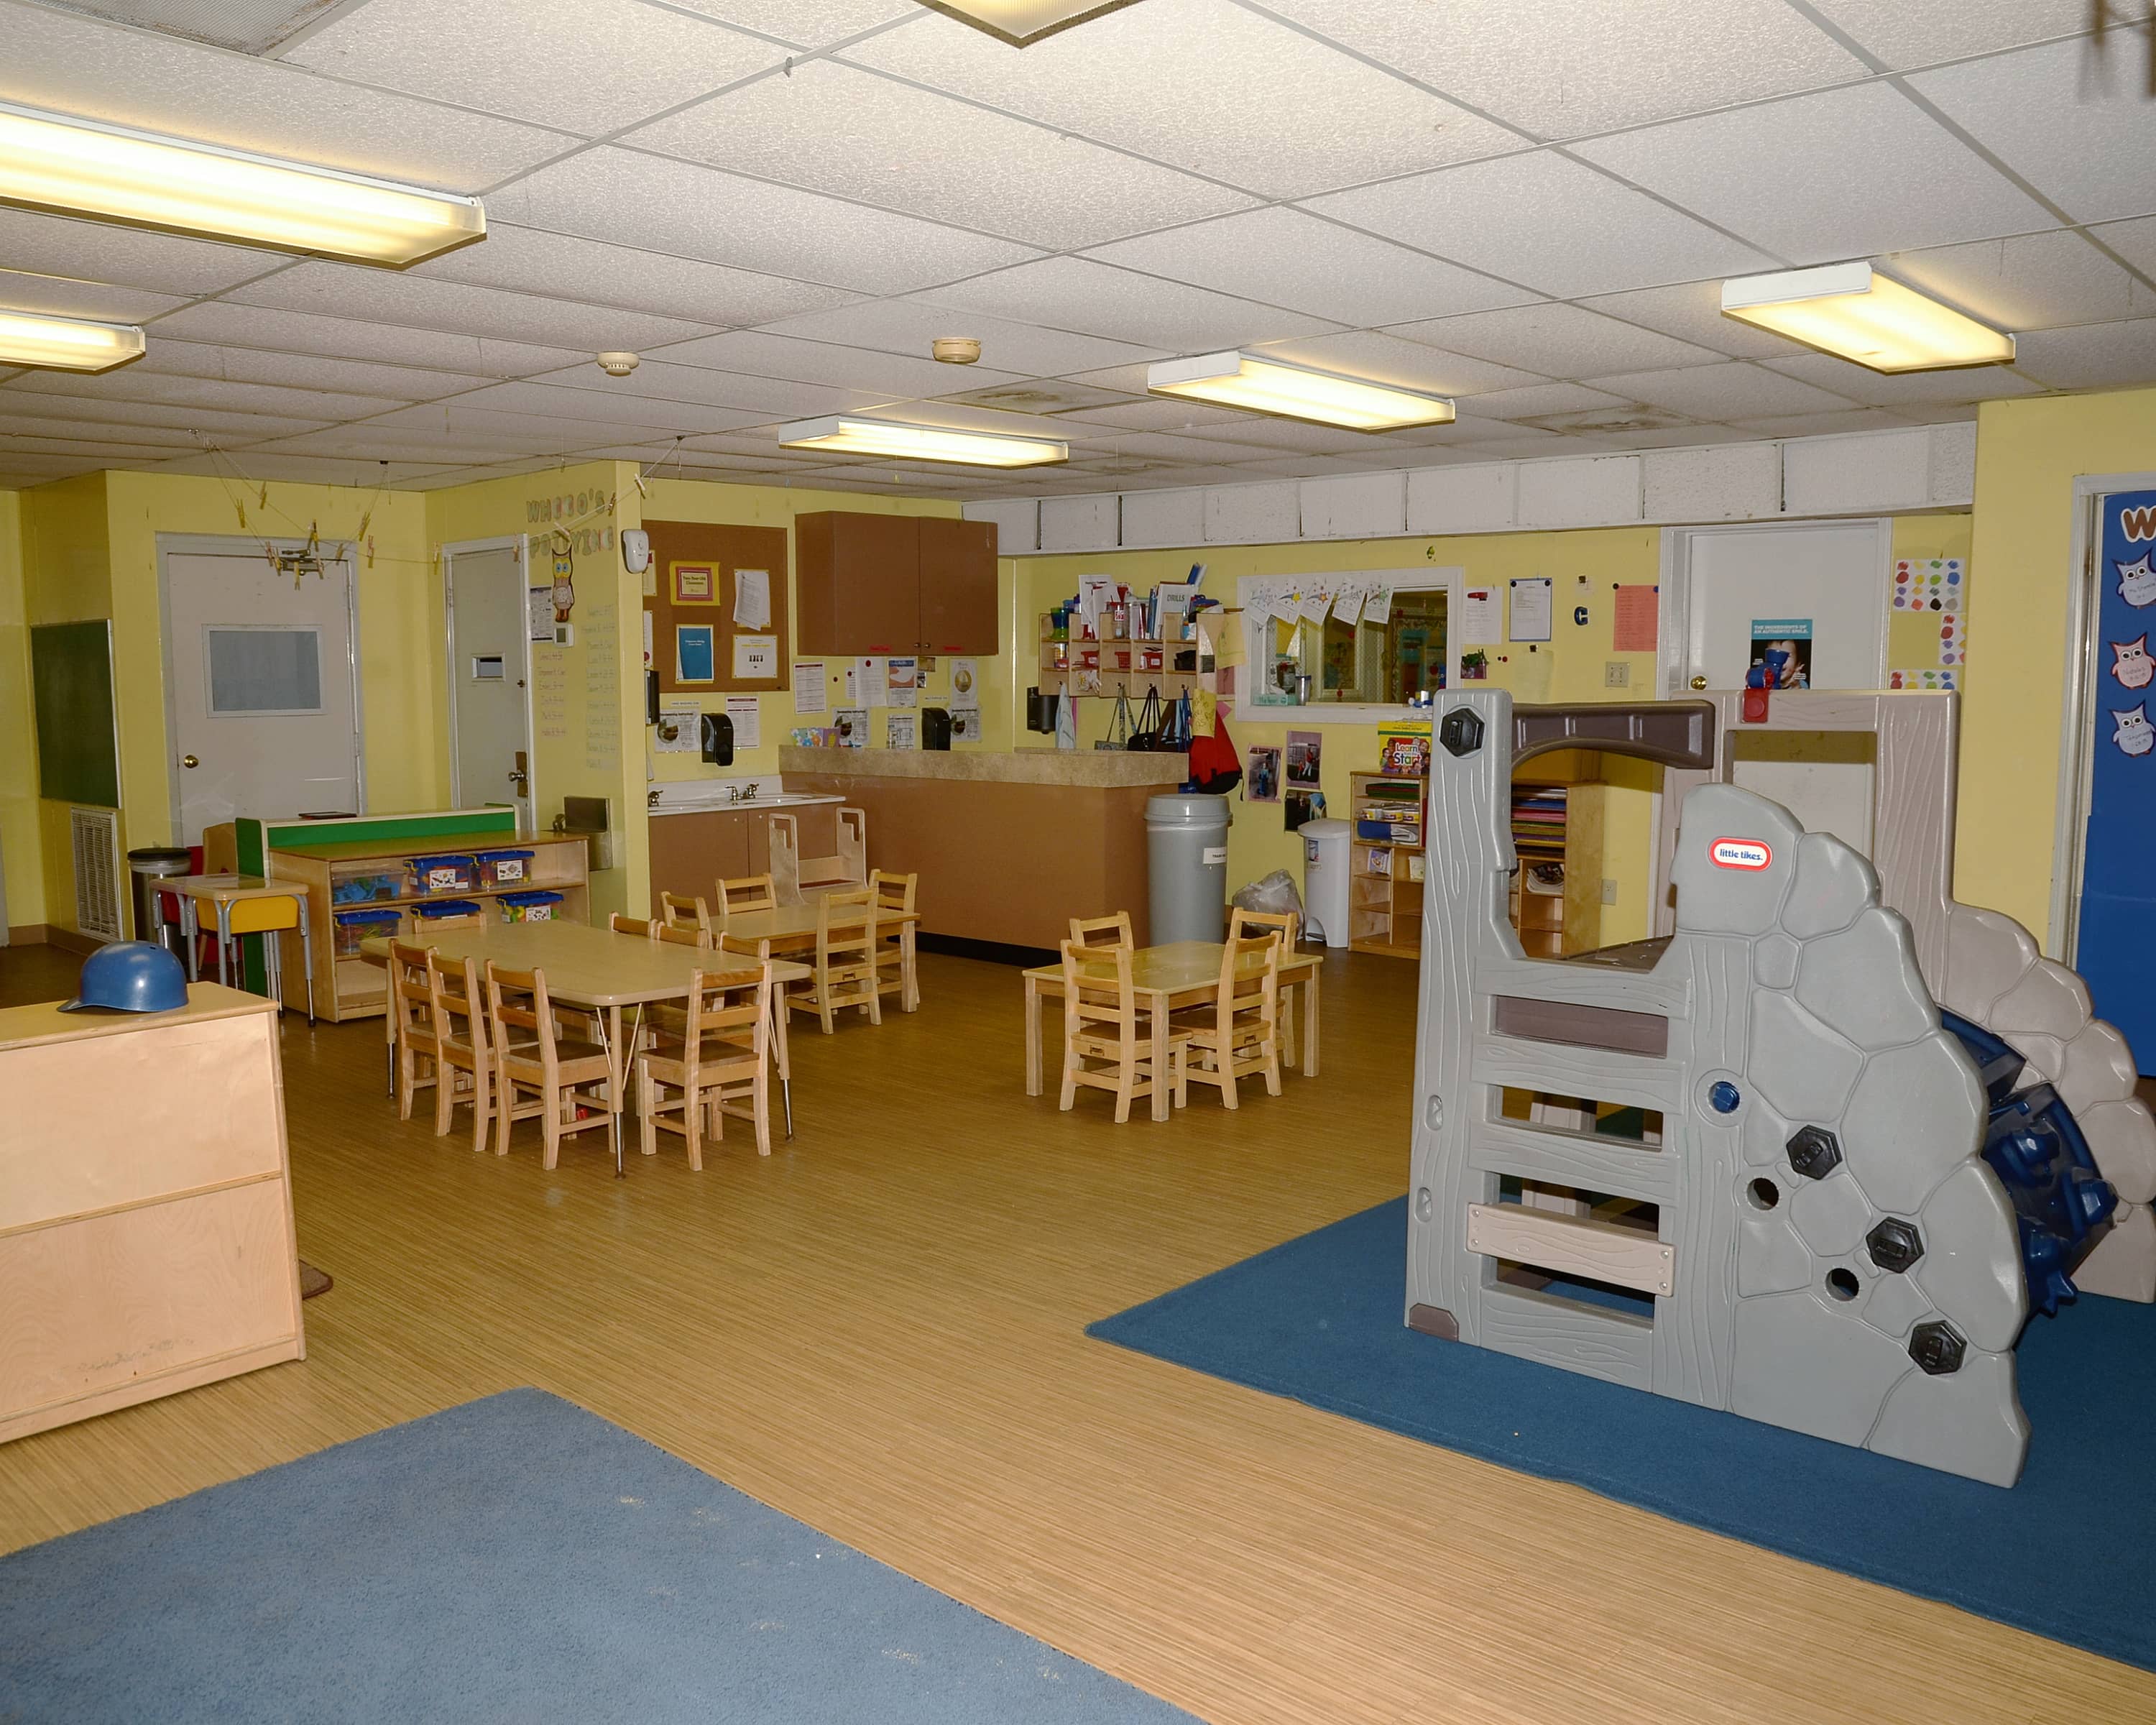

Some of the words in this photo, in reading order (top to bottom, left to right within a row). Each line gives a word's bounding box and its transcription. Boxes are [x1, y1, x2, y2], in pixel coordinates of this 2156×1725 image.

[1574, 606, 1589, 626] C
[1396, 743, 1417, 752] Learn
[1394, 753, 1421, 765] Start
[1720, 849, 1738, 858] little
